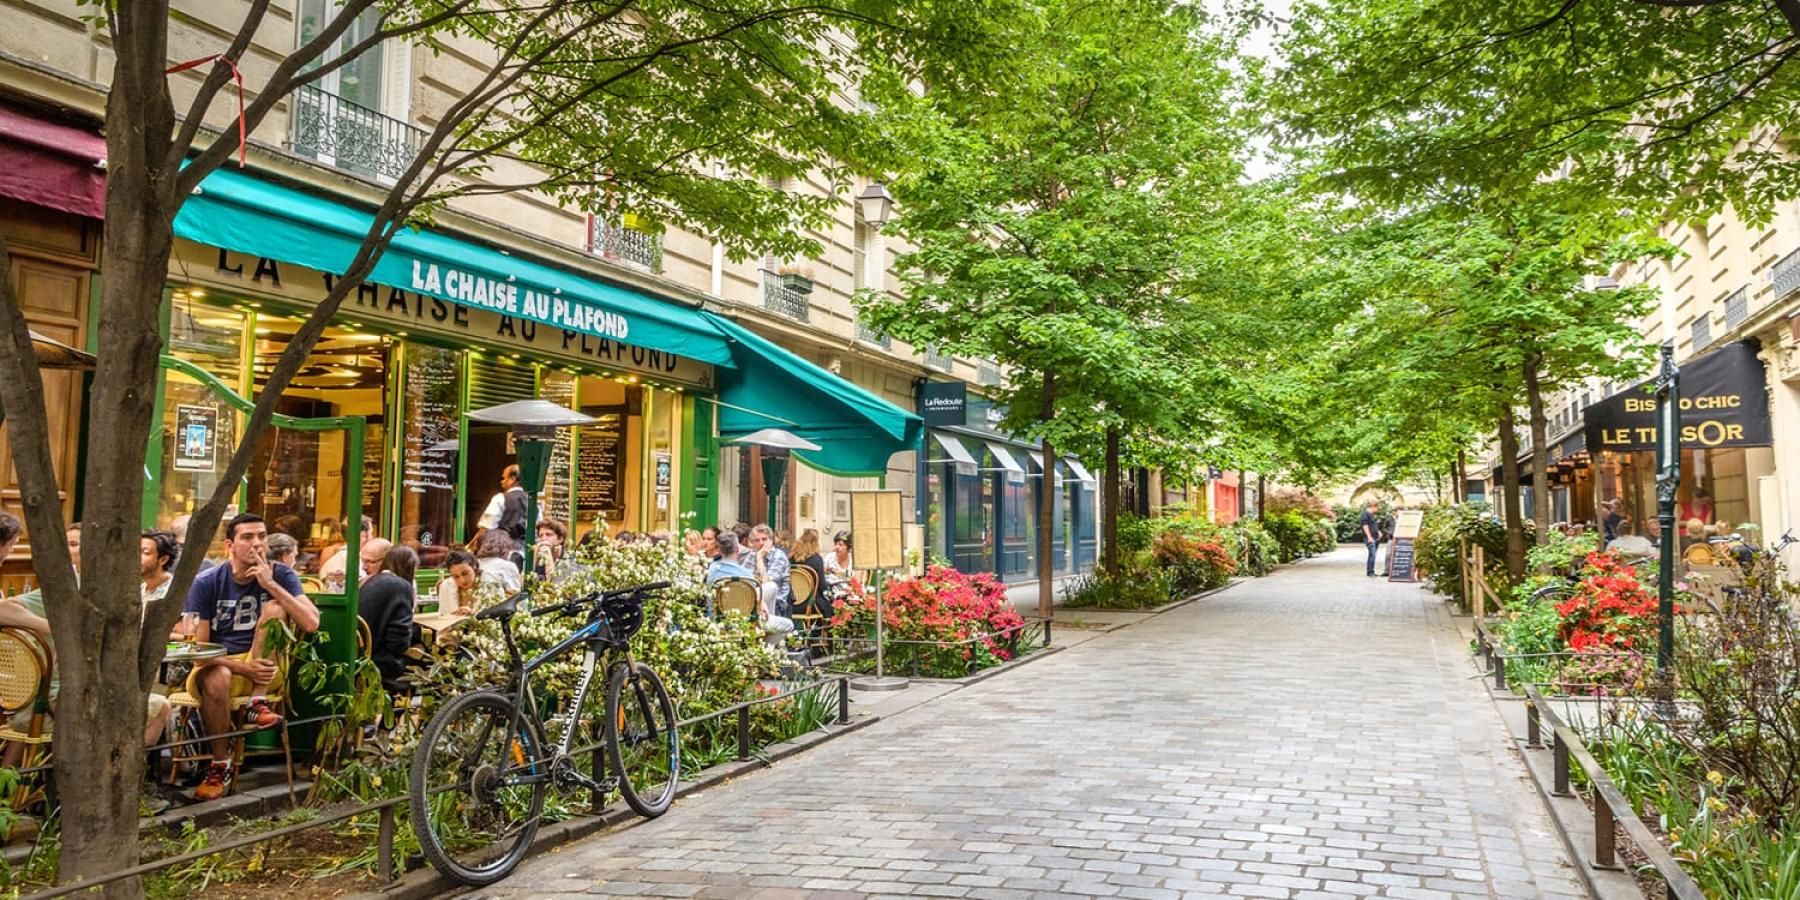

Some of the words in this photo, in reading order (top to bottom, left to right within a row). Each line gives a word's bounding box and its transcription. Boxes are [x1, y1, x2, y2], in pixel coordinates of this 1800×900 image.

[412, 259, 441, 295] LA
[522, 290, 550, 320] AU
[552, 297, 629, 339] PLAFOND
[1625, 398, 1692, 413] BISO
[1696, 395, 1741, 409] CHIC
[1602, 428, 1631, 444] LE
[1635, 420, 1744, 446] TSOR
[557, 670, 588, 746] ROCKRIDER
